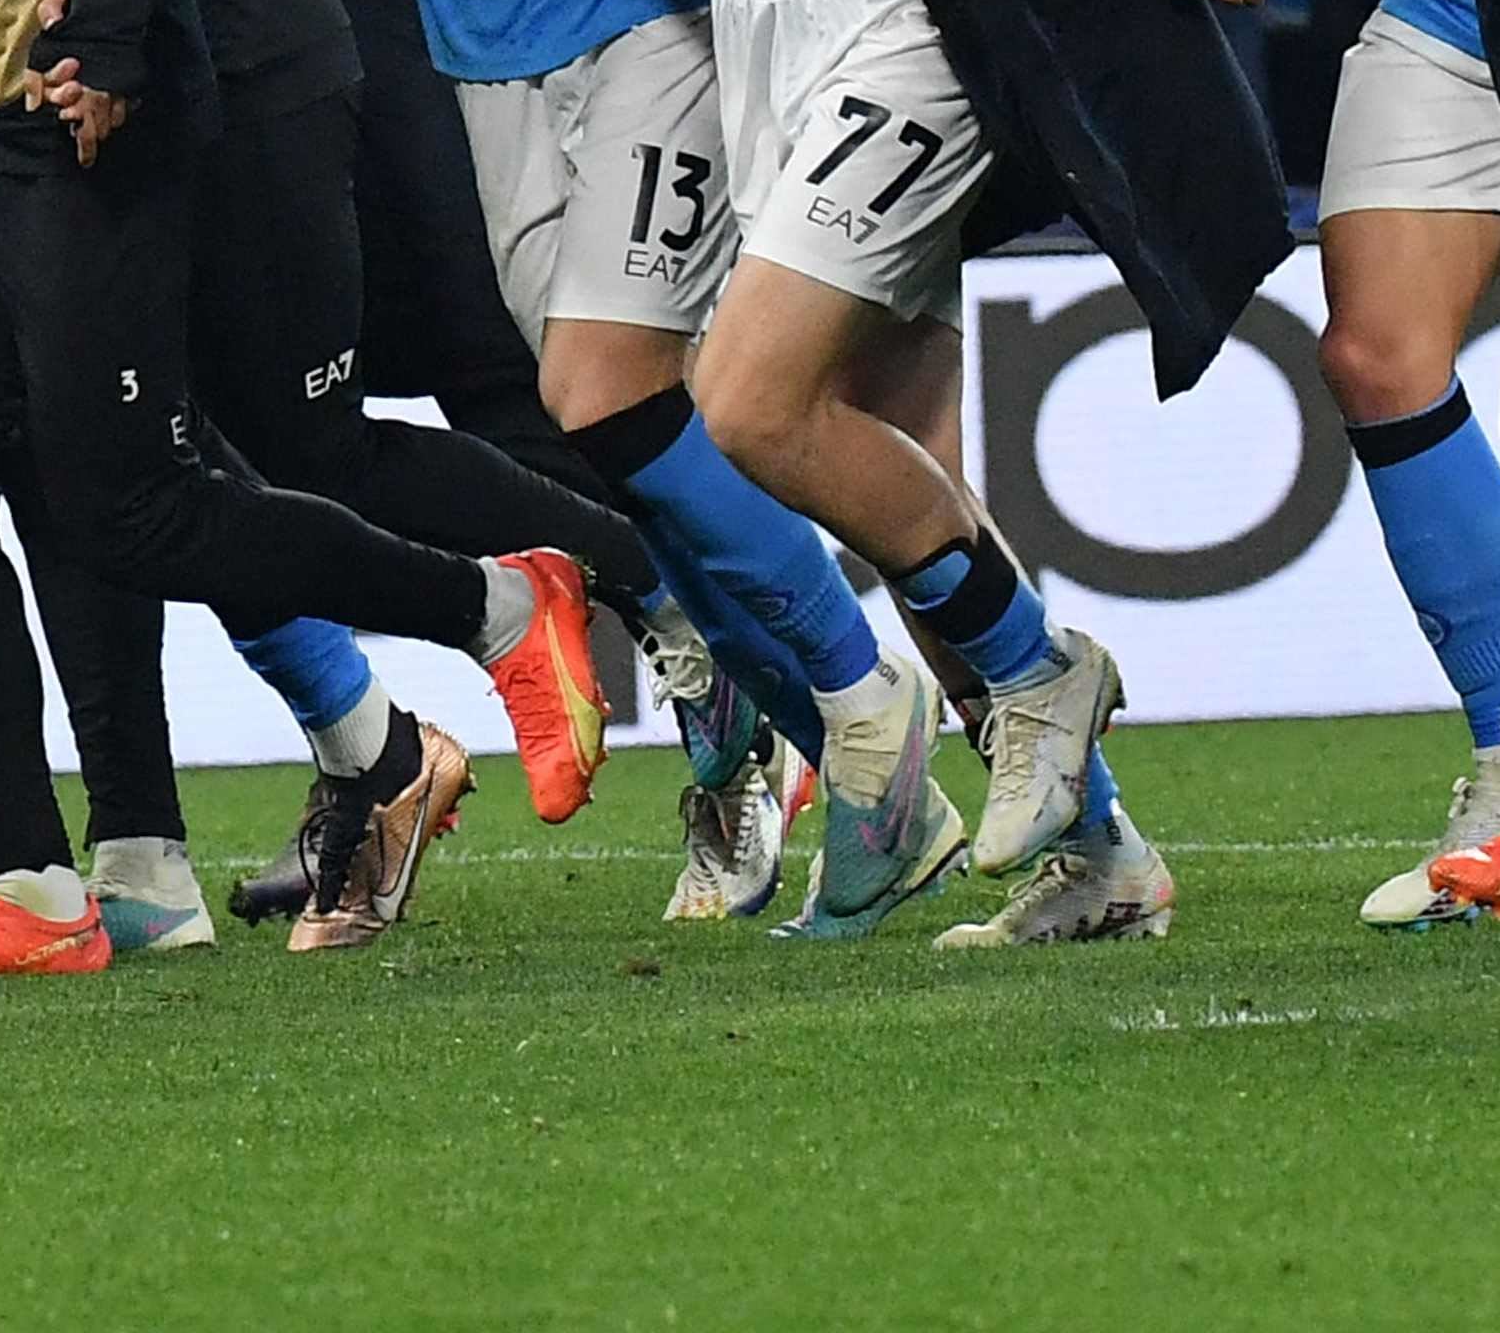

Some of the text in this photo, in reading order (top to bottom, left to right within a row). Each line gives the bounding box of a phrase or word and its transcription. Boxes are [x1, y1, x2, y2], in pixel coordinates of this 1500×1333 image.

[804, 94, 944, 217] 77
[631, 142, 712, 251] 13
[805, 195, 881, 247] EA7
[623, 249, 690, 286] EA7
[120, 368, 140, 403] 3
[304, 347, 357, 400] EA7
